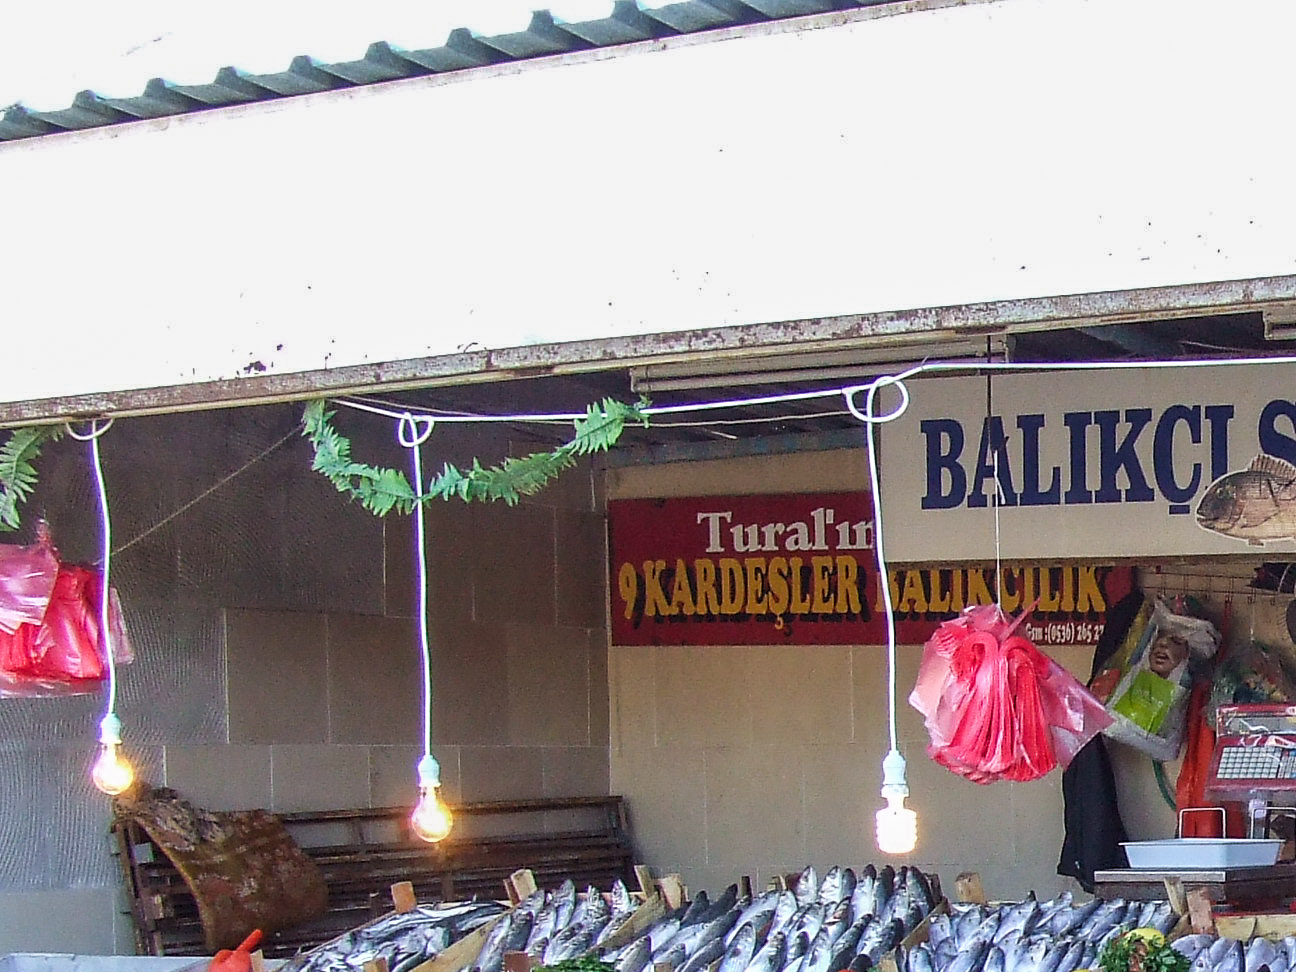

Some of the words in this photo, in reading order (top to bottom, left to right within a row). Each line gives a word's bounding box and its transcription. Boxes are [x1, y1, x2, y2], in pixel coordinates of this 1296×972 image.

[920, 404, 1235, 515] BALIKÇI
[618, 562, 637, 619] 9
[643, 555, 861, 630] KARDEŞLER
